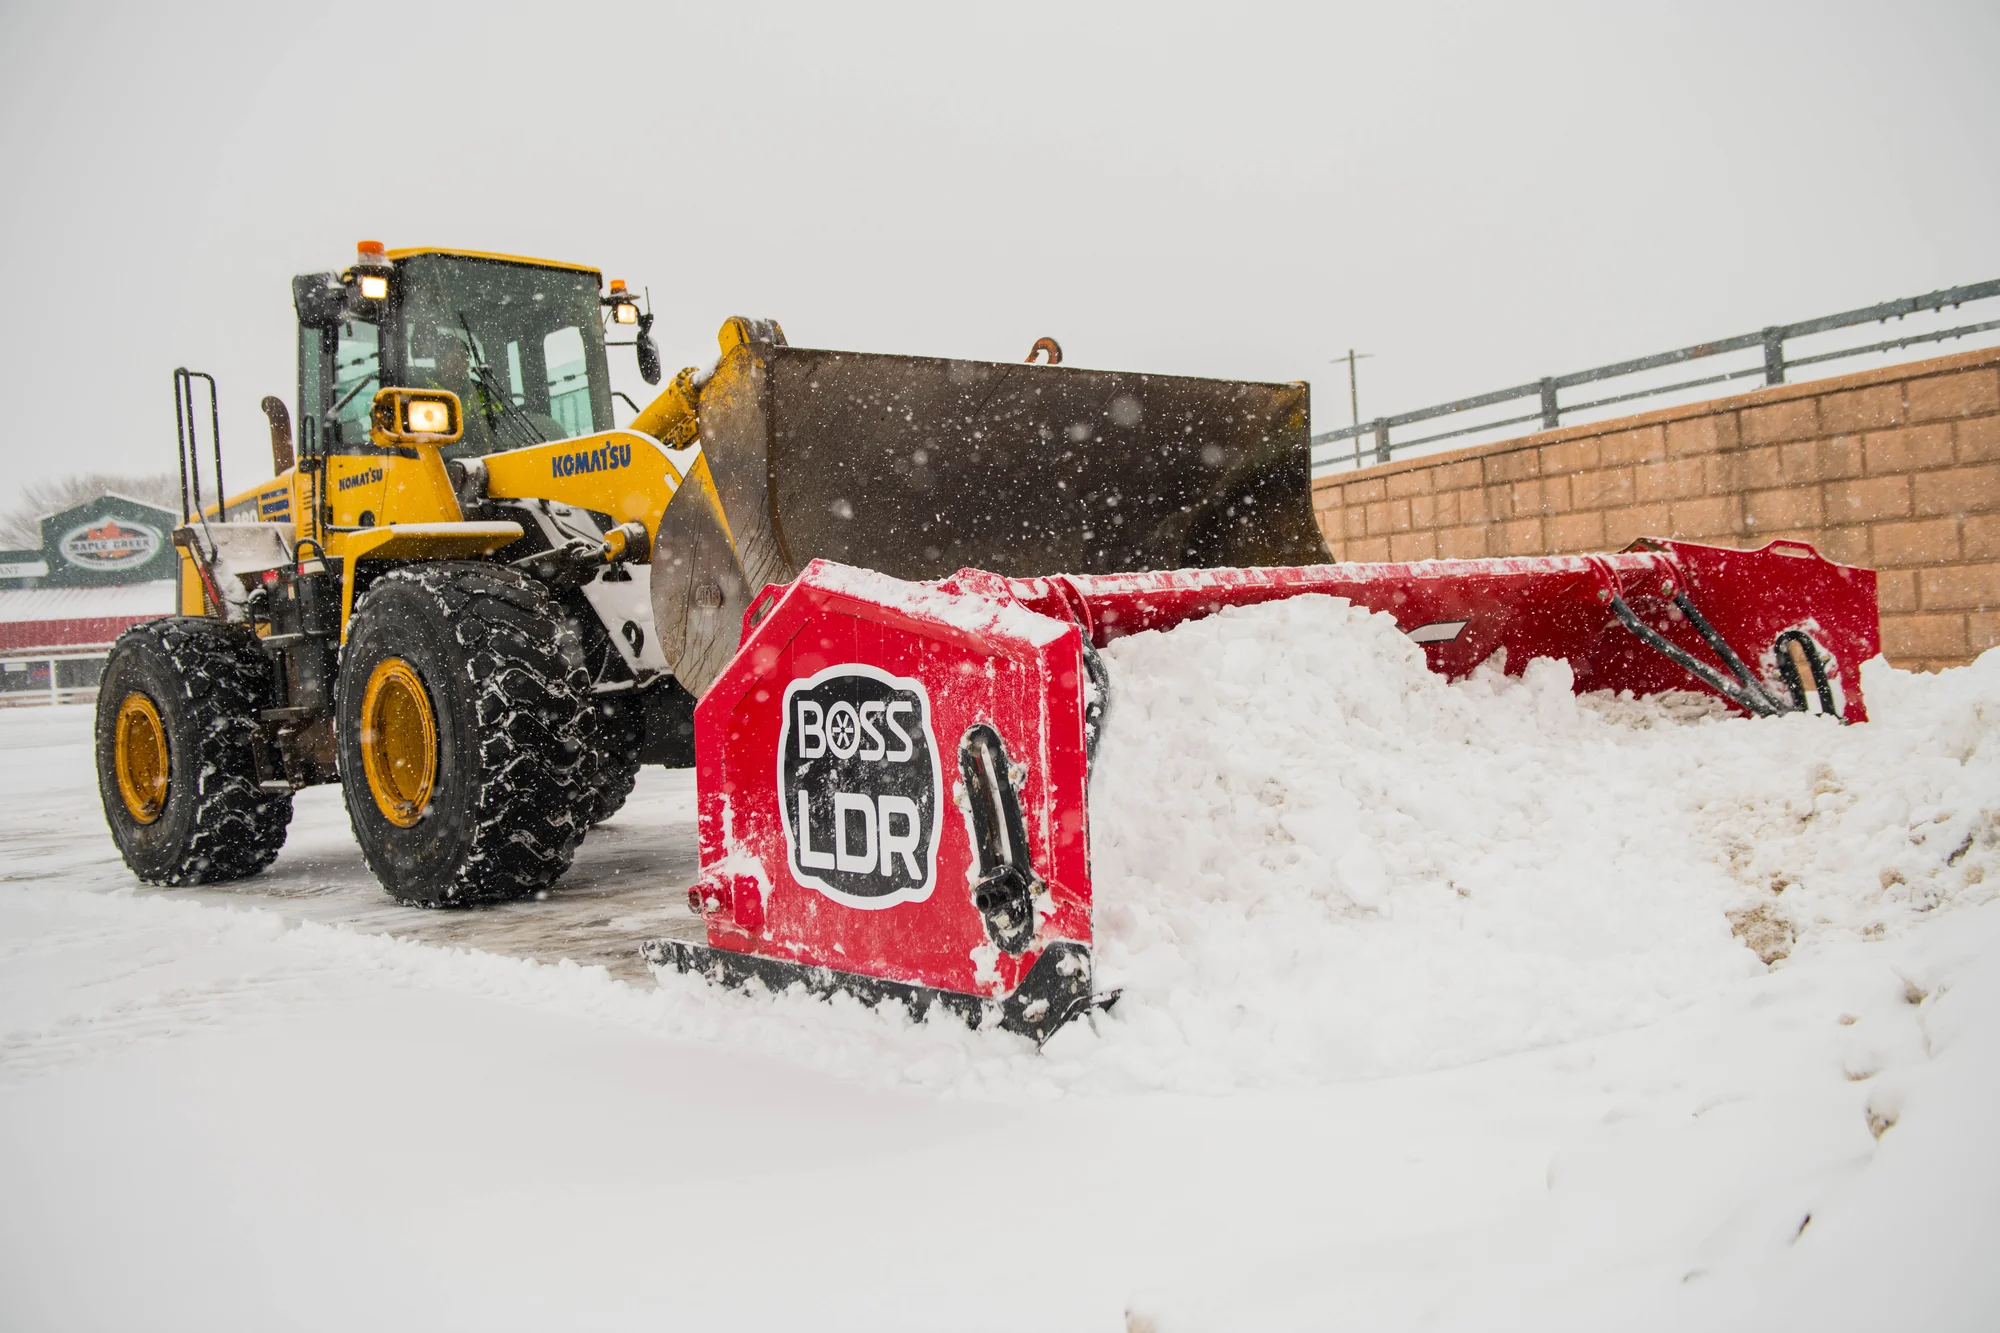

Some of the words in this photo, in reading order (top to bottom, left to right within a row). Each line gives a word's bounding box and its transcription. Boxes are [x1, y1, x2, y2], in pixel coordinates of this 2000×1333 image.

[552, 440, 631, 478] KOMATSU
[339, 466, 383, 492] KOMATSU
[69, 541, 108, 552] MAPLE
[113, 538, 150, 549] CREEK
[797, 700, 914, 763] BOSS
[798, 789, 923, 881] LDR
